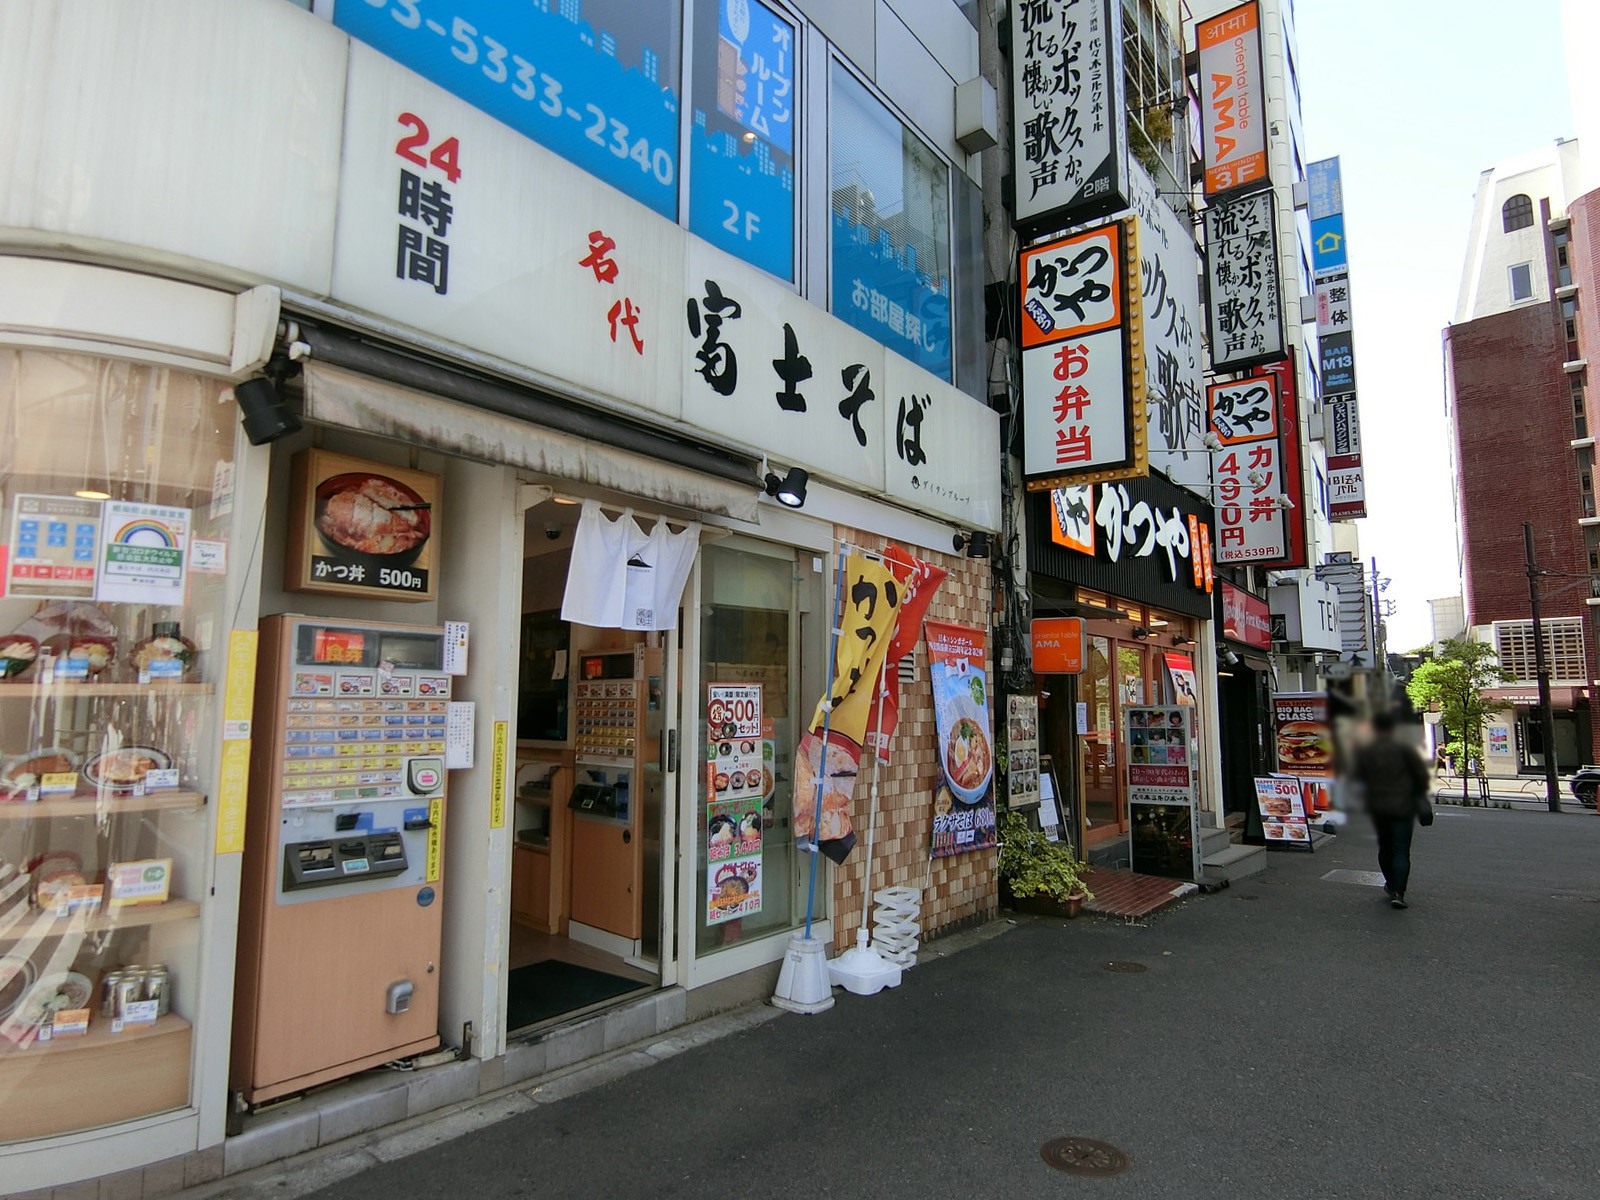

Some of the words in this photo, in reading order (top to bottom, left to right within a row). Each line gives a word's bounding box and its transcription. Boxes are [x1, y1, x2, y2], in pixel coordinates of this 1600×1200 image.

[772, 23, 791, 125] オープン
[1234, 37, 1248, 91] oriental
[750, 52, 771, 138] ルーム
[1211, 73, 1236, 163] AMA
[1238, 92, 1251, 130] table
[1083, 175, 1110, 199] 2階
[1215, 162, 1256, 189] 3F
[721, 200, 761, 241] 2F
[578, 230, 644, 355] 名代
[1027, 245, 1111, 323] かつや
[1329, 286, 1349, 326] 整体
[852, 278, 936, 352] お部屋探し
[687, 279, 932, 466] 富士そば
[1322, 355, 1353, 371] M13
[1052, 343, 1092, 465] お弁当
[1213, 386, 1271, 433] かつや
[1328, 473, 1362, 485] IBIZA
[1095, 482, 1190, 583] かつや
[314, 561, 365, 582] かつ丼
[379, 567, 422, 589] 500円
[1036, 640, 1061, 648] AMA
[1274, 784, 1299, 795] 500
